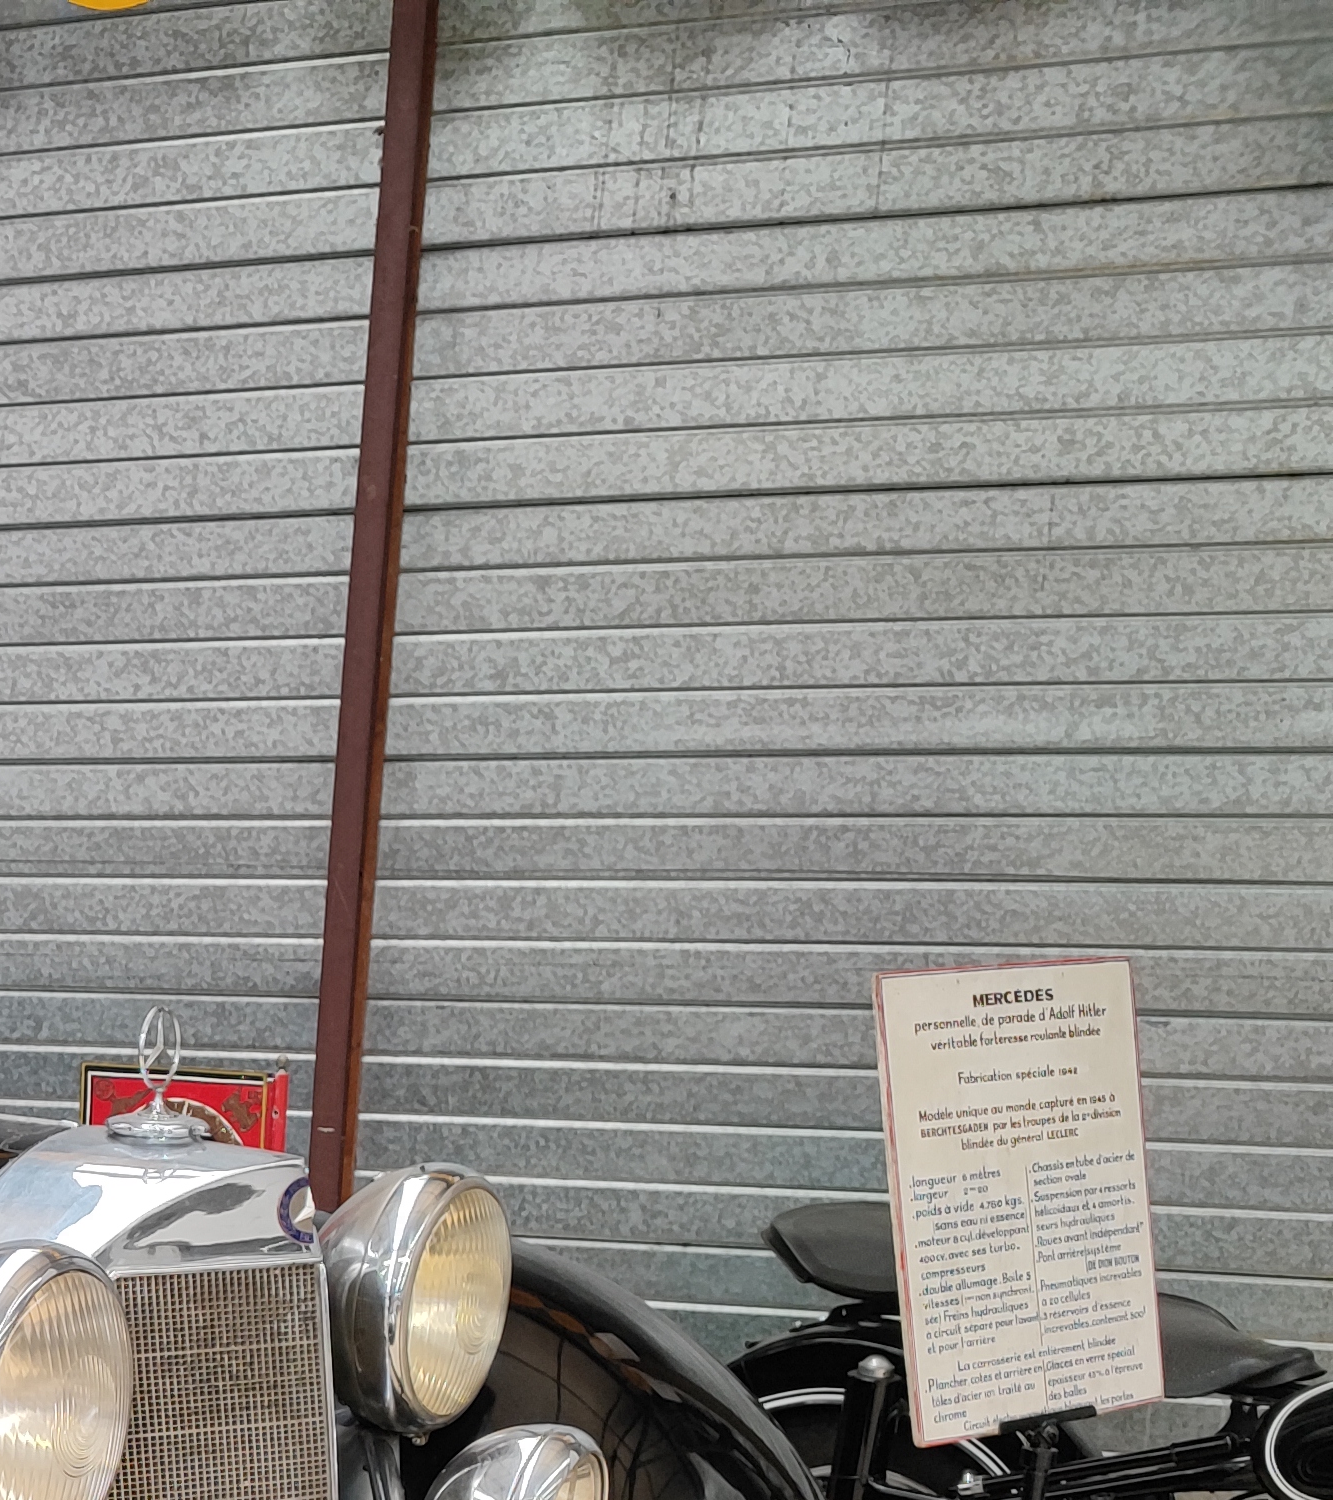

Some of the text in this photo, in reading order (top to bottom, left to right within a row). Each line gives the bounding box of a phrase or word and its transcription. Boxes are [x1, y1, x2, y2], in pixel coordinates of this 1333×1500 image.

[981, 1013, 994, 1026] de
[998, 1009, 1035, 1028] parade
[1039, 1004, 1075, 1021] d'Adolf
[1078, 1002, 1106, 1018] Hitler
[980, 1031, 1028, 1046] forteresse
[1030, 1026, 1067, 1041] roulante
[1068, 1023, 1101, 1038] blindée
[958, 1069, 1012, 1085] Fabrication
[1016, 1064, 1055, 1081] spéciale
[918, 1107, 953, 1122] Modèle
[956, 1106, 988, 1119] unique
[991, 1106, 1003, 1115] au
[1039, 1096, 1074, 1112] capturé
[1077, 1097, 1087, 1105] en
[993, 1122, 1007, 1133] par
[1010, 1116, 1022, 1129] les
[1023, 1110, 1056, 1128] troupes
[1058, 1112, 1069, 1123] de
[1071, 1110, 1080, 1122] la
[1088, 1108, 1121, 1120] division
[961, 1127, 1079, 1151] blindée du général LECLERC
[1075, 1154, 1094, 1168] tube
[1125, 1150, 1135, 1161] de
[969, 1165, 1001, 1181] mètres
[1033, 1169, 1086, 1187] section ovale
[1034, 1179, 1136, 1202] Suspension par ressorts
[944, 1205, 951, 1214] à
[953, 1200, 974, 1213] vide
[1082, 1200, 1091, 1211] et
[960, 1215, 988, 1227] eau ni
[1036, 1212, 1115, 1232] seurs hydrauliques
[975, 1223, 1029, 1240] développant
[1064, 1230, 1088, 1243] avant
[948, 1247, 987, 1260] avec ses
[921, 1264, 986, 1281] compresseurs
[1040, 1273, 1098, 1292] Pneumatiques
[1060, 1289, 1091, 1304] cellules
[943, 1299, 1029, 1322] Freins hydrauliques
[934, 1323, 962, 1339] circuit
[995, 1319, 1014, 1330] pour
[927, 1342, 936, 1355] et
[938, 1342, 959, 1354] pour
[957, 1361, 970, 1372] La
[972, 1352, 1021, 1370] carrosserie
[1024, 1348, 1036, 1360] est
[1075, 1358, 1084, 1366] en
[1086, 1354, 1105, 1363] verre
[994, 1370, 1002, 1381] et
[1003, 1367, 1032, 1379] arrière
[1024, 1383, 1035, 1391] au
[1049, 1384, 1087, 1401] des balles
[934, 1410, 967, 1424] chrome
